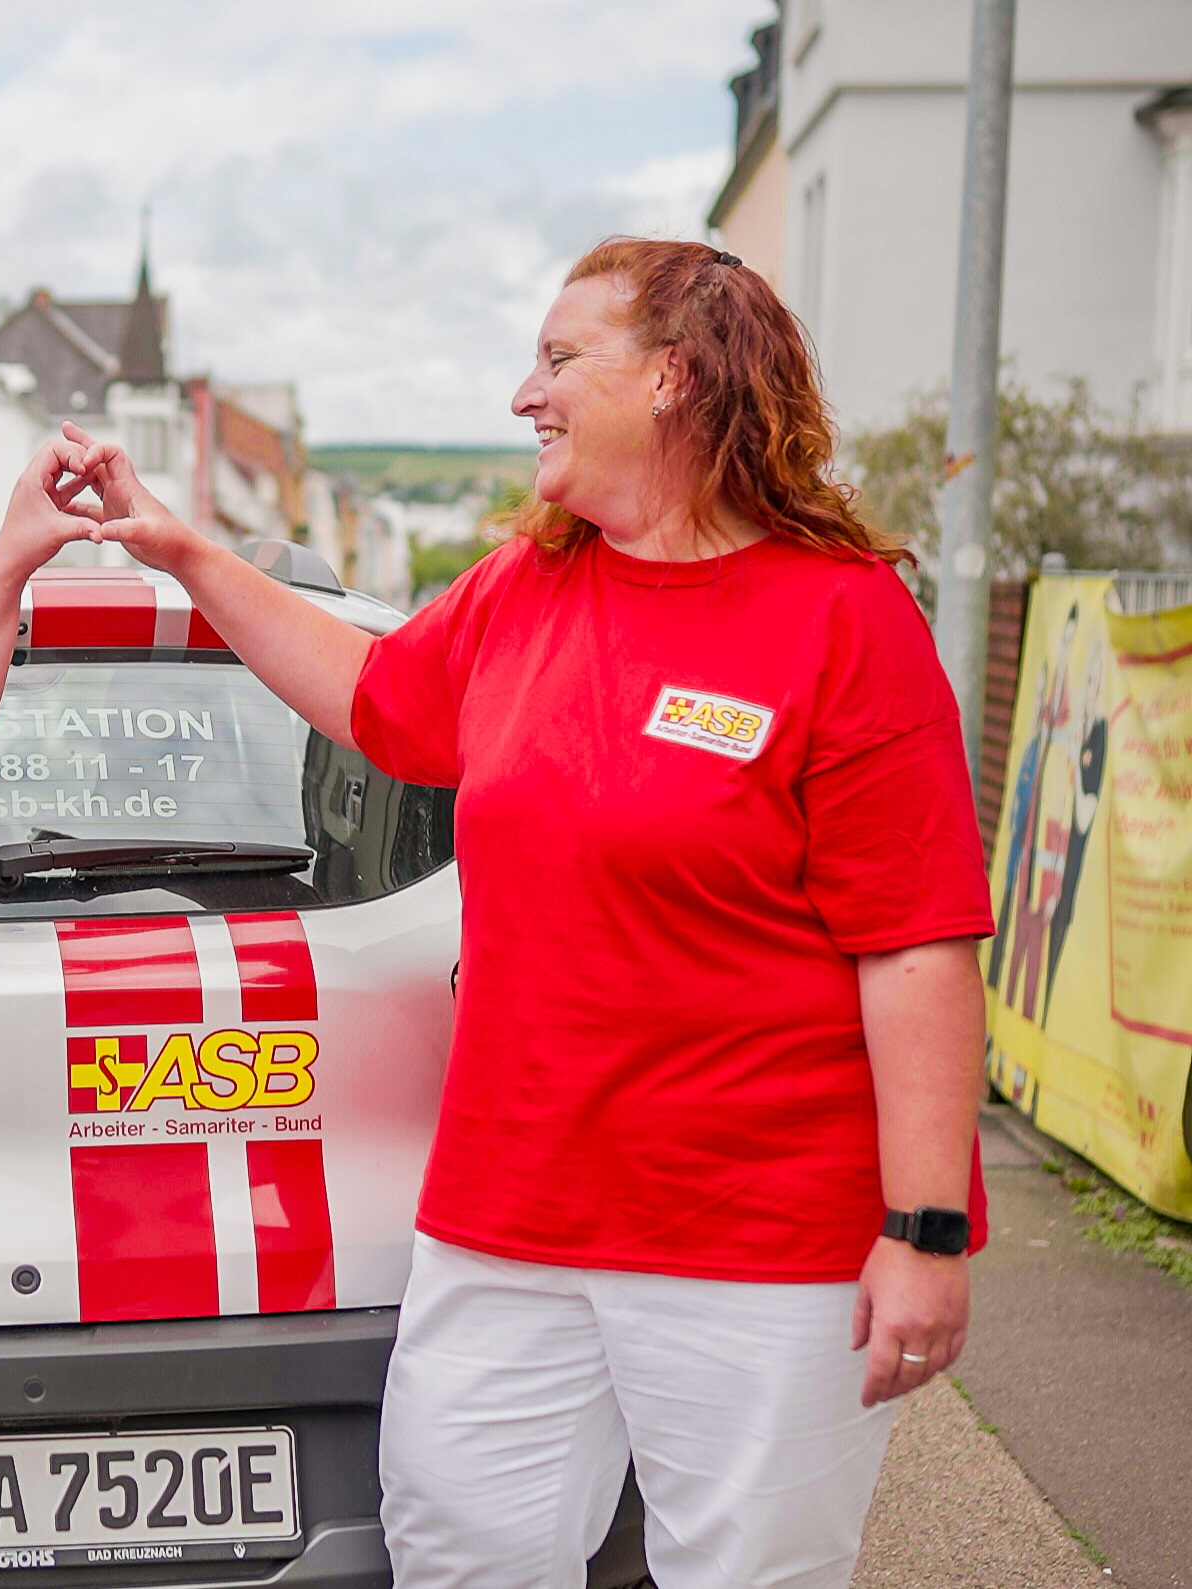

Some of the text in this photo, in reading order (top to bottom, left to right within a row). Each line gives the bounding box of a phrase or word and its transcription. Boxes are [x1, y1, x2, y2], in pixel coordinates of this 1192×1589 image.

[680, 701, 762, 742] ASB
[0, 753, 51, 781] 88
[67, 753, 109, 780] 11
[157, 754, 205, 781] 17
[125, 1029, 320, 1111] ASB
[69, 1120, 146, 1138] Arbeiter
[165, 1116, 255, 1136] Samariter
[275, 1114, 322, 1132] Bund
[50, 1445, 283, 1531] 7520E
[87, 1549, 111, 1562] BAD
[114, 1546, 183, 1560] KREUZNACH
